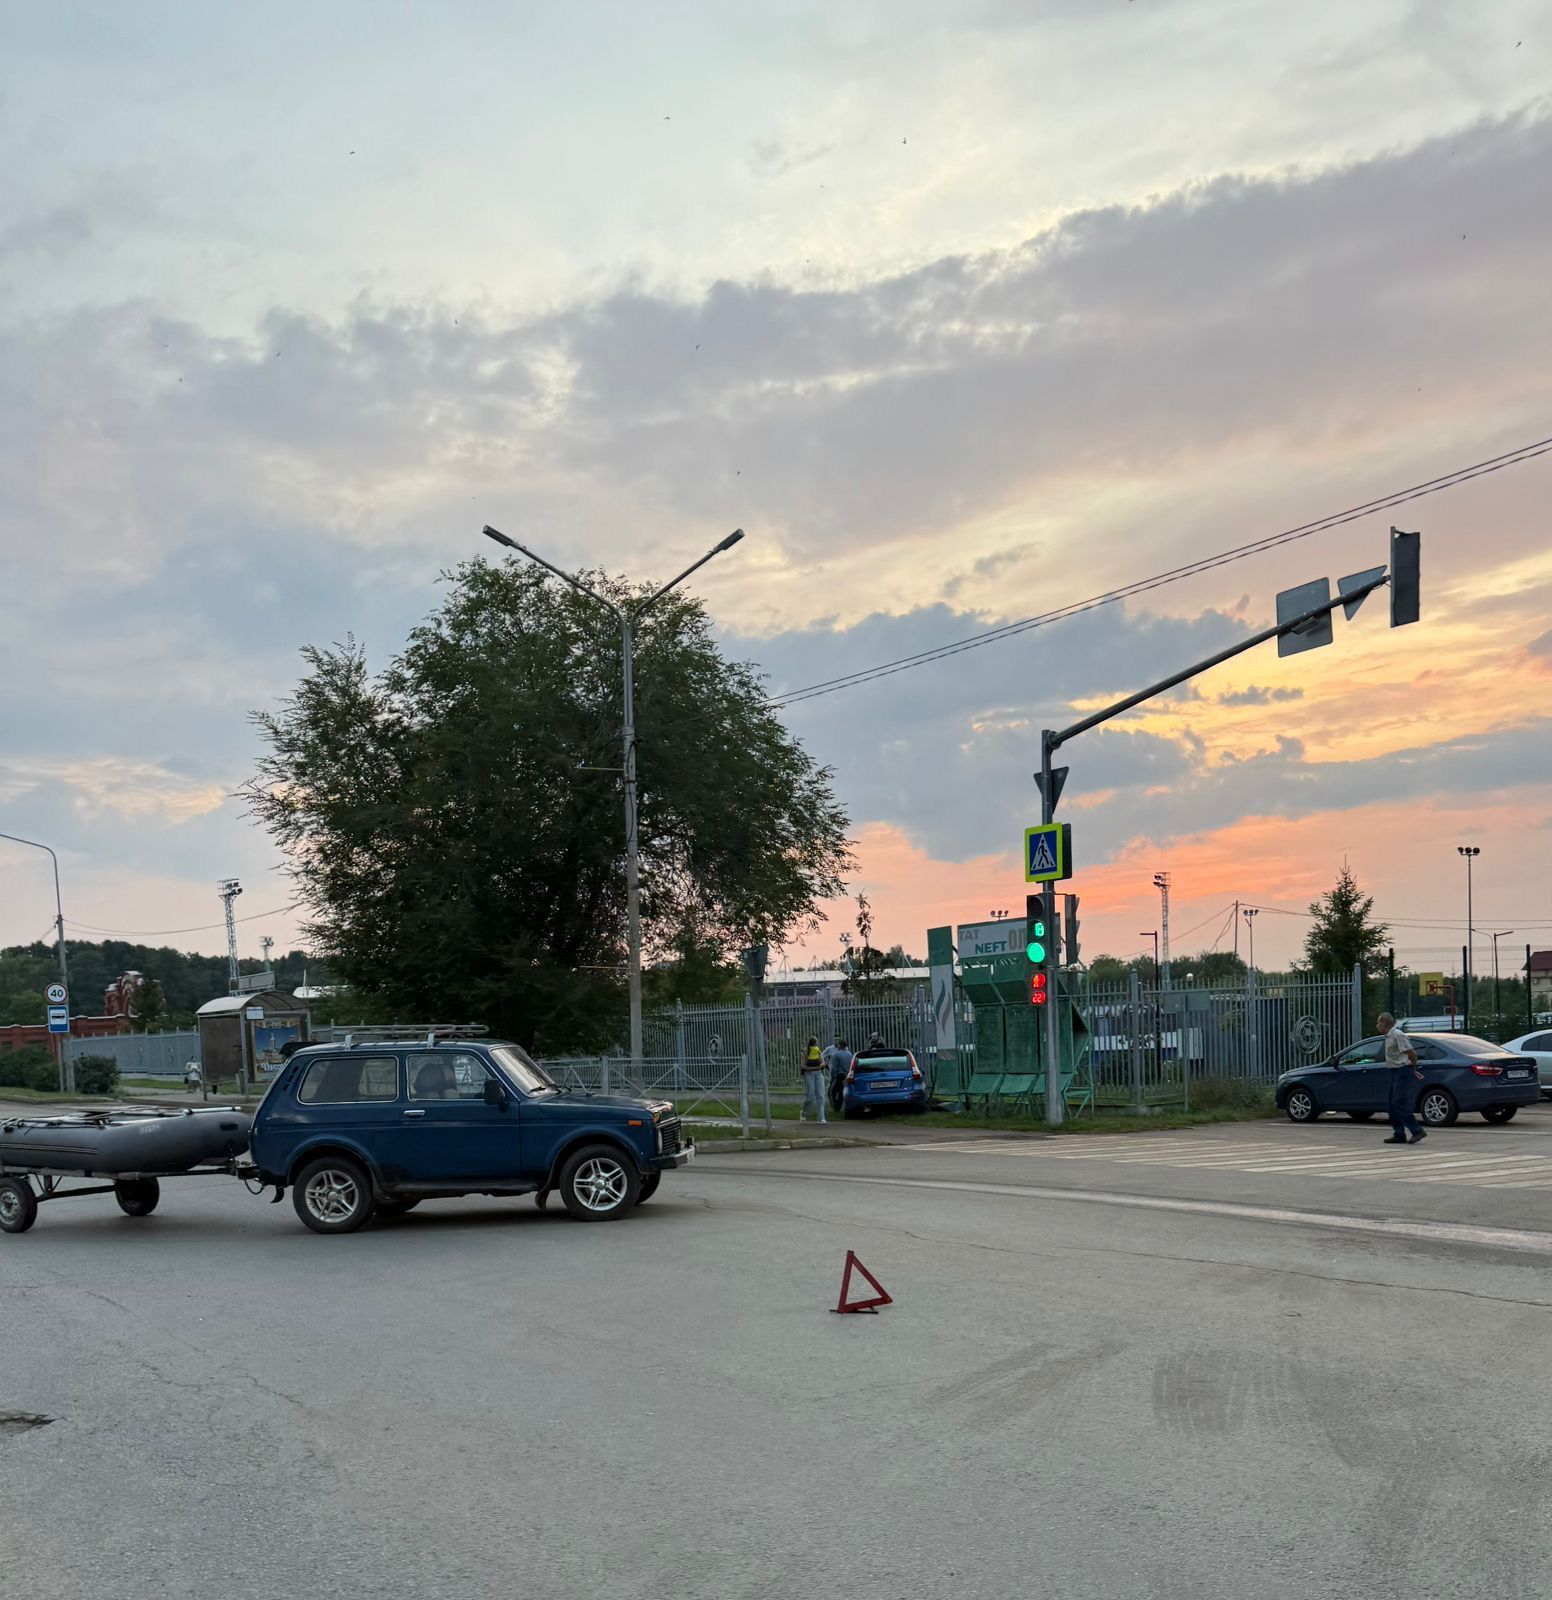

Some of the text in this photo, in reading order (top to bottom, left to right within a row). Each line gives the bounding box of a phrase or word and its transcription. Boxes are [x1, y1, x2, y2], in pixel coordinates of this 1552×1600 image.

[959, 929, 980, 941] TAT
[975, 940, 1007, 955] NEFT
[50, 989, 64, 998] 40
